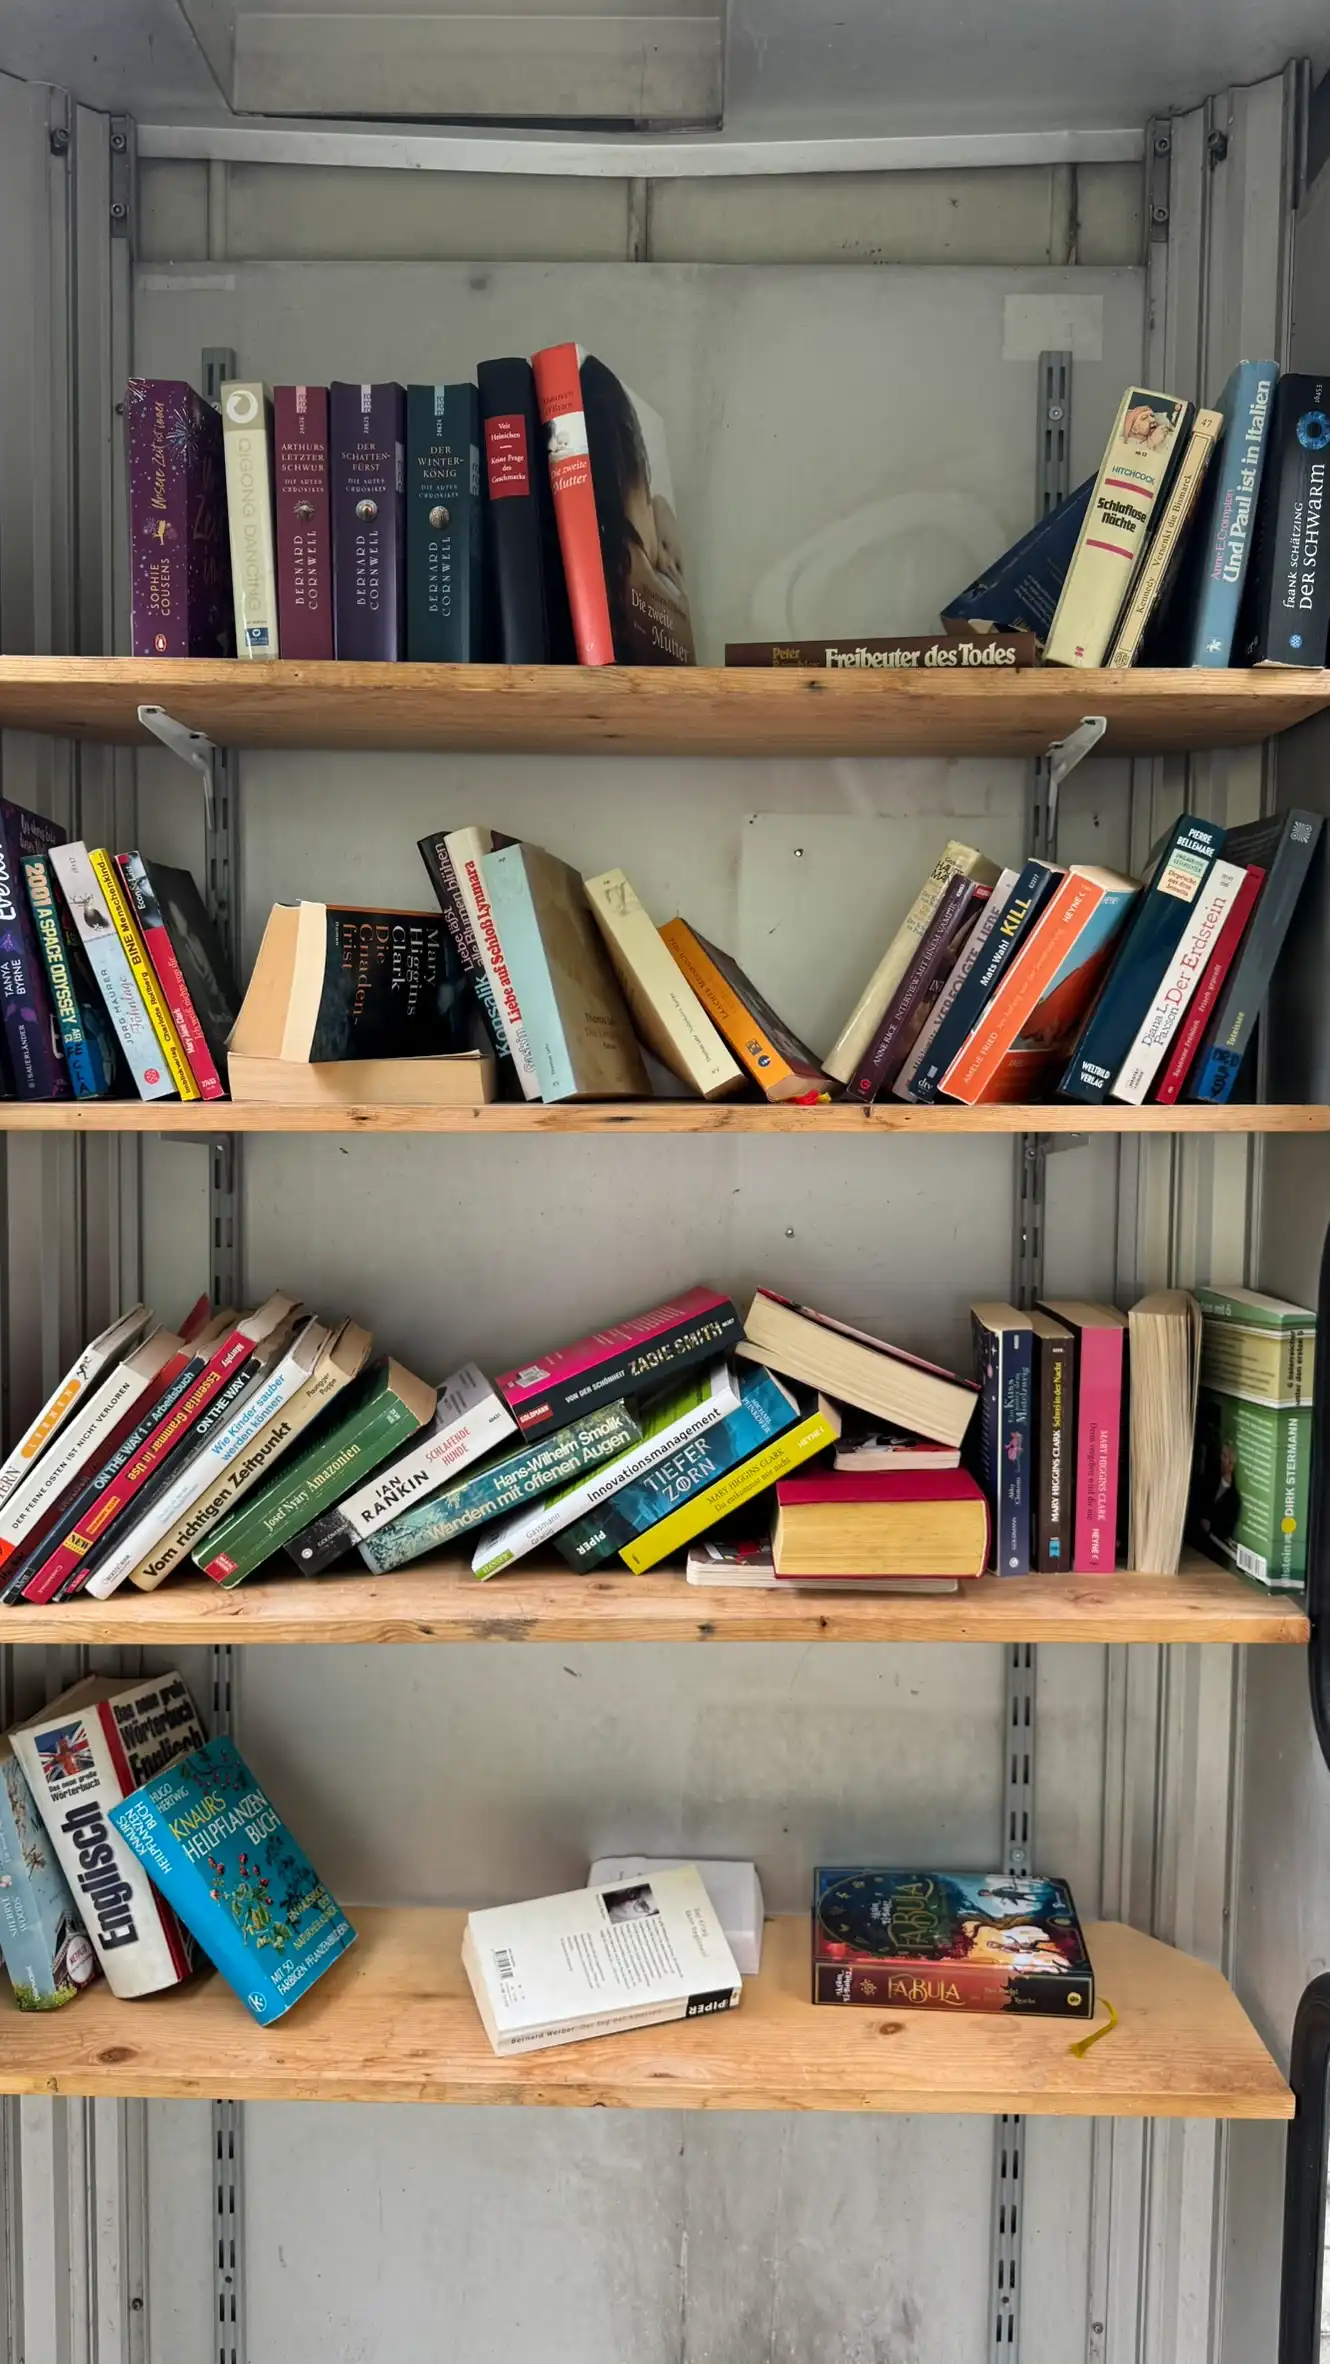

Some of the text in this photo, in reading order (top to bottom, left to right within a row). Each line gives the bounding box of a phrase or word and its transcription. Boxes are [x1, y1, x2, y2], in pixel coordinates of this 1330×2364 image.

[491, 432, 521, 441] Heinichen
[1201, 418, 1213, 428] 47
[282, 464, 325, 472] SCHWUR
[342, 452, 391, 461] SCHATTEN-
[352, 462, 380, 471] FÜRST
[418, 456, 465, 466] WINTER-
[430, 446, 452, 455] DER
[238, 437, 255, 518] QIGONG
[423, 468, 457, 478] KÖNIG
[553, 473, 588, 493] Mutter
[1112, 465, 1156, 485] HITCHCOCK
[1222, 380, 1272, 583] Und Paul ist in Italien
[1097, 498, 1147, 523] Schlaflose
[1136, 474, 1193, 614] Kennedy Versenkt die Bismarck
[150, 563, 160, 609] SOPHIE
[161, 558, 170, 616] COUSENS
[246, 524, 262, 611] DANCING
[294, 536, 304, 606] BERNARD
[308, 530, 318, 610] CORNWELL
[356, 536, 366, 606] BERNARD
[370, 530, 379, 611] CORNWELL
[428, 542, 439, 613] BERNARD
[442, 536, 451, 617] CORNWELL
[631, 588, 647, 614] Die
[647, 605, 674, 630] zweite
[652, 626, 689, 663] Mutter
[772, 647, 800, 660] Peter
[825, 642, 1016, 668] Freibeuter des Todes
[1177, 836, 1216, 857] BELLEMARE
[1189, 828, 1213, 844] PIERRE
[24, 863, 52, 907] 2001
[36, 908, 53, 919] A
[1000, 898, 1032, 937] KILL
[40, 919, 60, 963] SPACE
[342, 924, 358, 968] frist
[376, 924, 389, 964] Die
[391, 925, 406, 992] Clark
[424, 928, 440, 987] Mary
[464, 860, 522, 1024] Liebe auf Schloß Lynmara
[1164, 970, 1193, 1007] Der
[1180, 896, 1228, 972] Erdstein
[0, 962, 12, 998] TANYA
[12, 959, 26, 995] BYRNE
[353, 923, 373, 1025] Gnaden-
[406, 926, 423, 1017] Higgins
[980, 941, 1010, 987] Mats Wahl
[51, 964, 77, 1024] ODYSSEY
[102, 968, 122, 1013] MAURER
[1153, 1006, 1180, 1046] Paxson
[918, 1077, 934, 1091] dtv
[1080, 1072, 1104, 1089] VERLAG
[1082, 1061, 1111, 1079] WELTBILD
[221, 1342, 245, 1367] Murphy
[627, 1345, 674, 1377] ZADIE
[674, 1320, 724, 1356] SMITH
[184, 1371, 220, 1413] Essential
[196, 1371, 251, 1434] ON THE WAY 1
[319, 1378, 338, 1395] Poppe
[565, 1369, 626, 1404] VON DER SCHÖNHEIT
[1016, 1366, 1030, 1423] Mistelzweig
[93, 1372, 194, 1491] ON THE WAY 1 Arbeitsbuch
[150, 1413, 186, 1453] Grammar
[212, 1374, 285, 1455] Wie Kinder sauber
[224, 1394, 284, 1461] werden können
[520, 1404, 550, 1424] GOLDMANN
[743, 1397, 771, 1434] PEINKOFER
[12, 1513, 28, 1530] DER
[26, 1489, 47, 1512] FERNE
[45, 1462, 68, 1487] OSTEN
[67, 1448, 79, 1461] IST
[78, 1425, 98, 1447] NICHT
[96, 1382, 131, 1422] VERLOREN
[426, 1426, 472, 1464] SCHLAFENDE
[442, 1442, 469, 1467] HUNDE
[494, 1414, 624, 1491] Hans-Wilhelm Smolik
[587, 1406, 721, 1504] Innovationsmanagement
[642, 1436, 712, 1492] TIEFER
[128, 1462, 147, 1481] Use
[264, 1444, 361, 1532] Josef Nyáry Amazonien
[376, 1476, 402, 1497] IAN
[428, 1430, 632, 1542] Wandern mit offenen Augen
[661, 1459, 718, 1503] ZORN
[1284, 1418, 1298, 1517] DIRK STERMANN
[142, 1546, 177, 1577] Vom
[177, 1489, 233, 1548] richtigen
[228, 1424, 292, 1487] Zeitpunkt
[362, 1470, 430, 1523] RANKIN
[526, 1511, 561, 1541] Gassmann
[576, 1530, 607, 1556] PIPER
[482, 1552, 513, 1574] HANSER
[48, 1770, 98, 1794] Das neue große
[51, 1778, 101, 1803] Wörterbuch
[150, 1783, 173, 1802] HUGO
[156, 1786, 190, 1814] HERTWIG
[116, 1814, 147, 1856] KNAURS
[135, 1802, 158, 1830] BUCH
[168, 1792, 227, 1843] KNAURS
[182, 1789, 268, 1864] HEILPFLANZEN
[245, 1810, 282, 1846] BUCH
[124, 1810, 172, 1875] HEILPFLANZEN
[58, 1800, 140, 1951] Englisch
[1, 1897, 18, 1939] SHERRYL
[14, 1896, 28, 1933] WOODS
[888, 1878, 934, 1949] FABULA
[688, 1998, 727, 2016] PIPER
[888, 1974, 966, 2006] FABULA
